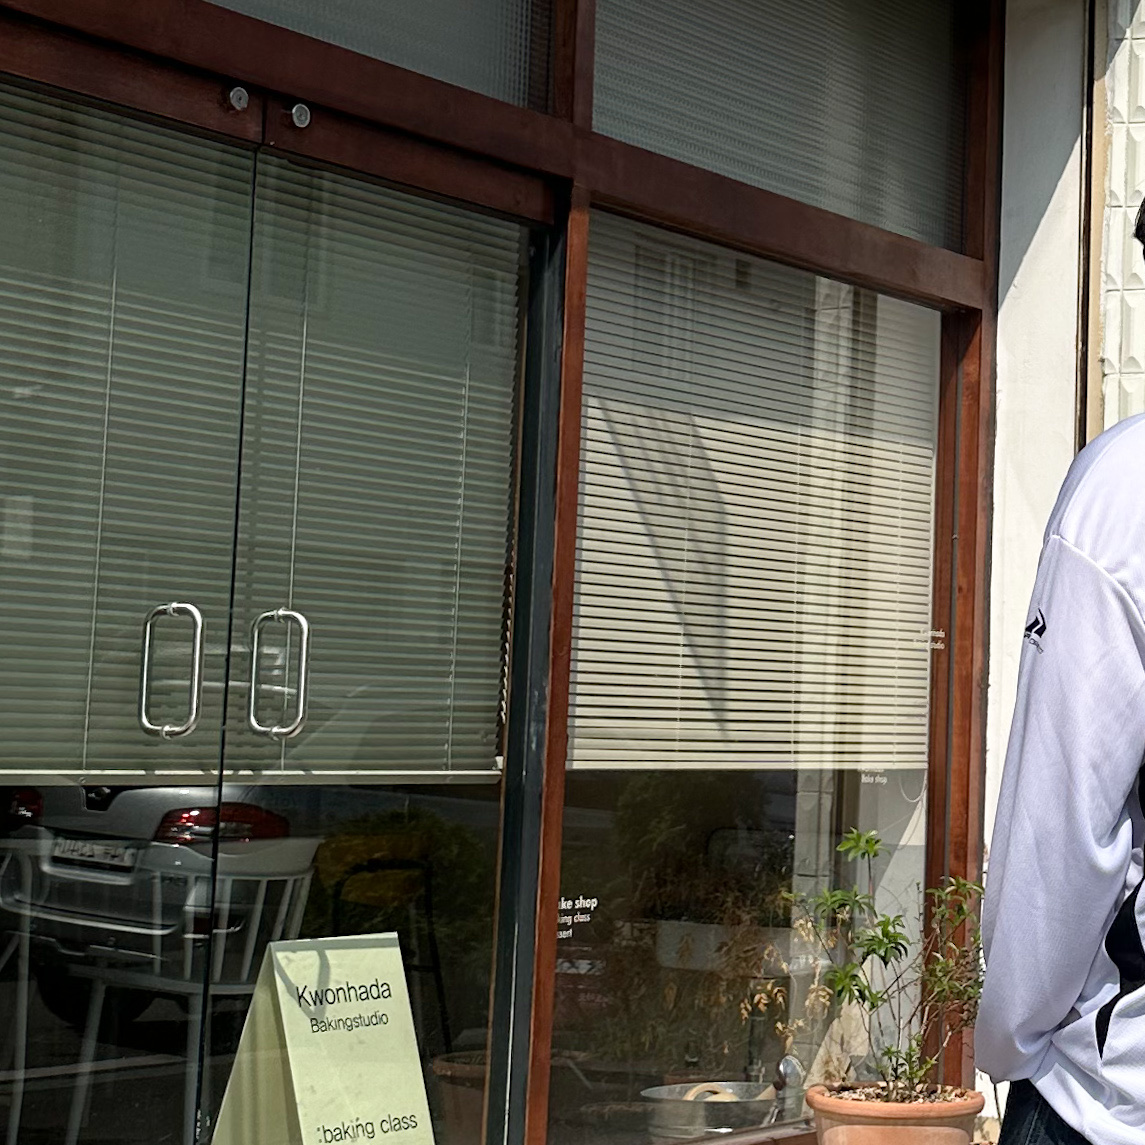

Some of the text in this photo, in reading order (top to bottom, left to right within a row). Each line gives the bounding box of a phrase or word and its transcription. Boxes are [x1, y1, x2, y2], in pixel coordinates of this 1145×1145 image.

[574, 895, 598, 911] shop
[296, 978, 392, 1008] Kwonhada
[310, 1010, 389, 1034] Bakingstudio
[380, 1113, 418, 1134] class
